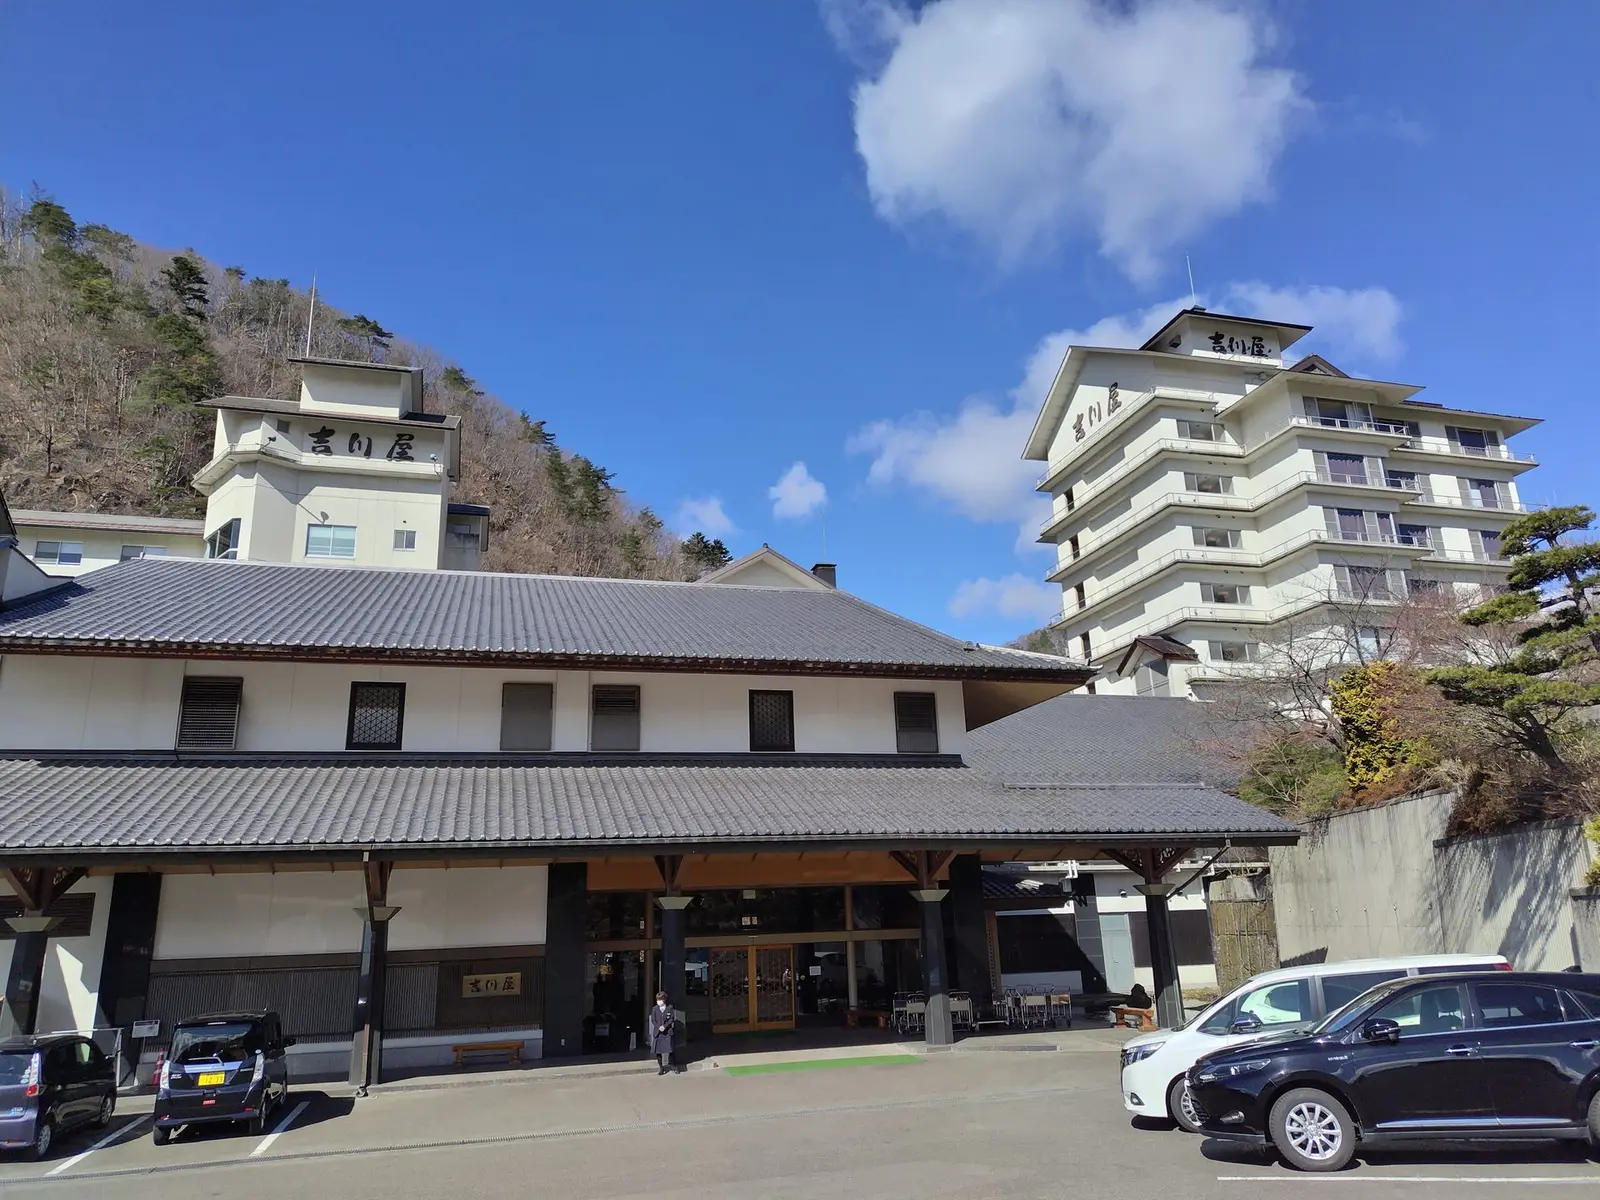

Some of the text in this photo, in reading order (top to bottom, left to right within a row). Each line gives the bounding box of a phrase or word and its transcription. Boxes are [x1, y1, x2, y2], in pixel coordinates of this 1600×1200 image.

[1208, 331, 1271, 357] 吉川屋
[1072, 381, 1122, 443] 吉川屋
[308, 425, 414, 462] 吉川屋
[468, 976, 515, 993] 吉川屋
